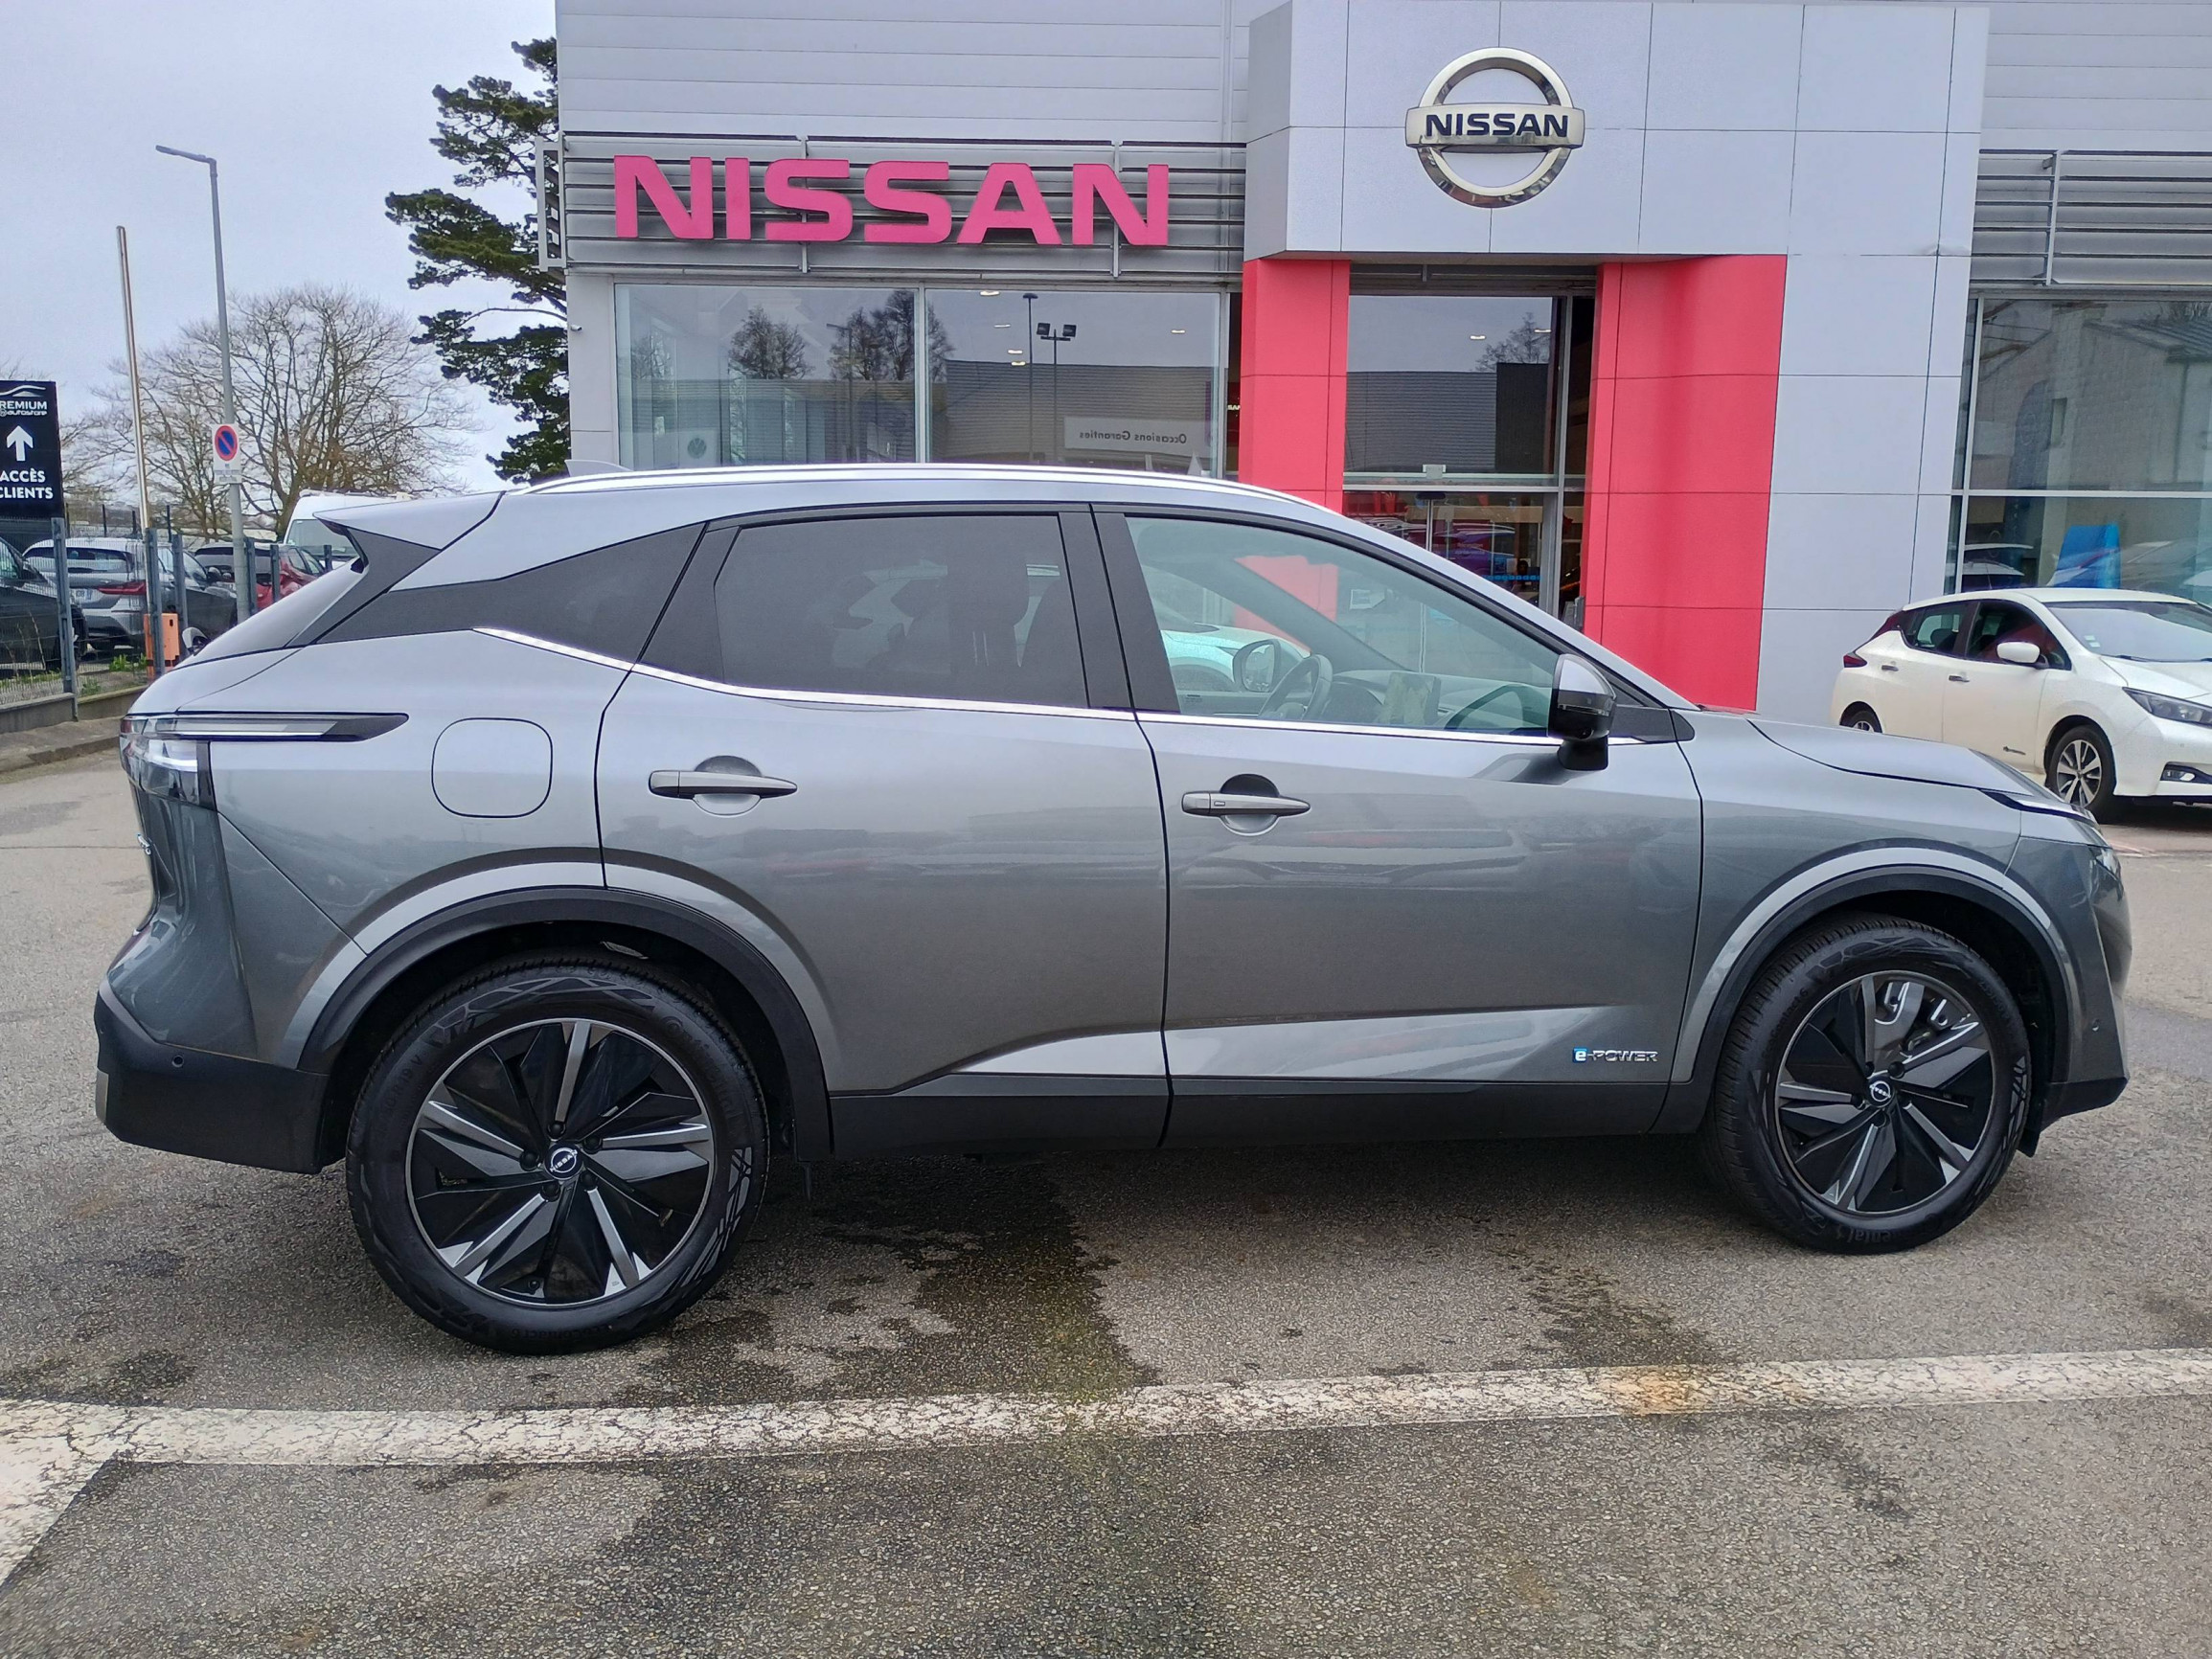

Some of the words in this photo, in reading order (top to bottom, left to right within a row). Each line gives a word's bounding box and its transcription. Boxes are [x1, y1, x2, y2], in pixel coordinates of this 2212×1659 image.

[1425, 113, 1568, 137] NISSAN
[614, 155, 1169, 246] NISSAN
[0, 400, 47, 410] REMIUM
[0, 467, 46, 483] ACCÈS
[1573, 1048, 1658, 1062] e-POWER
